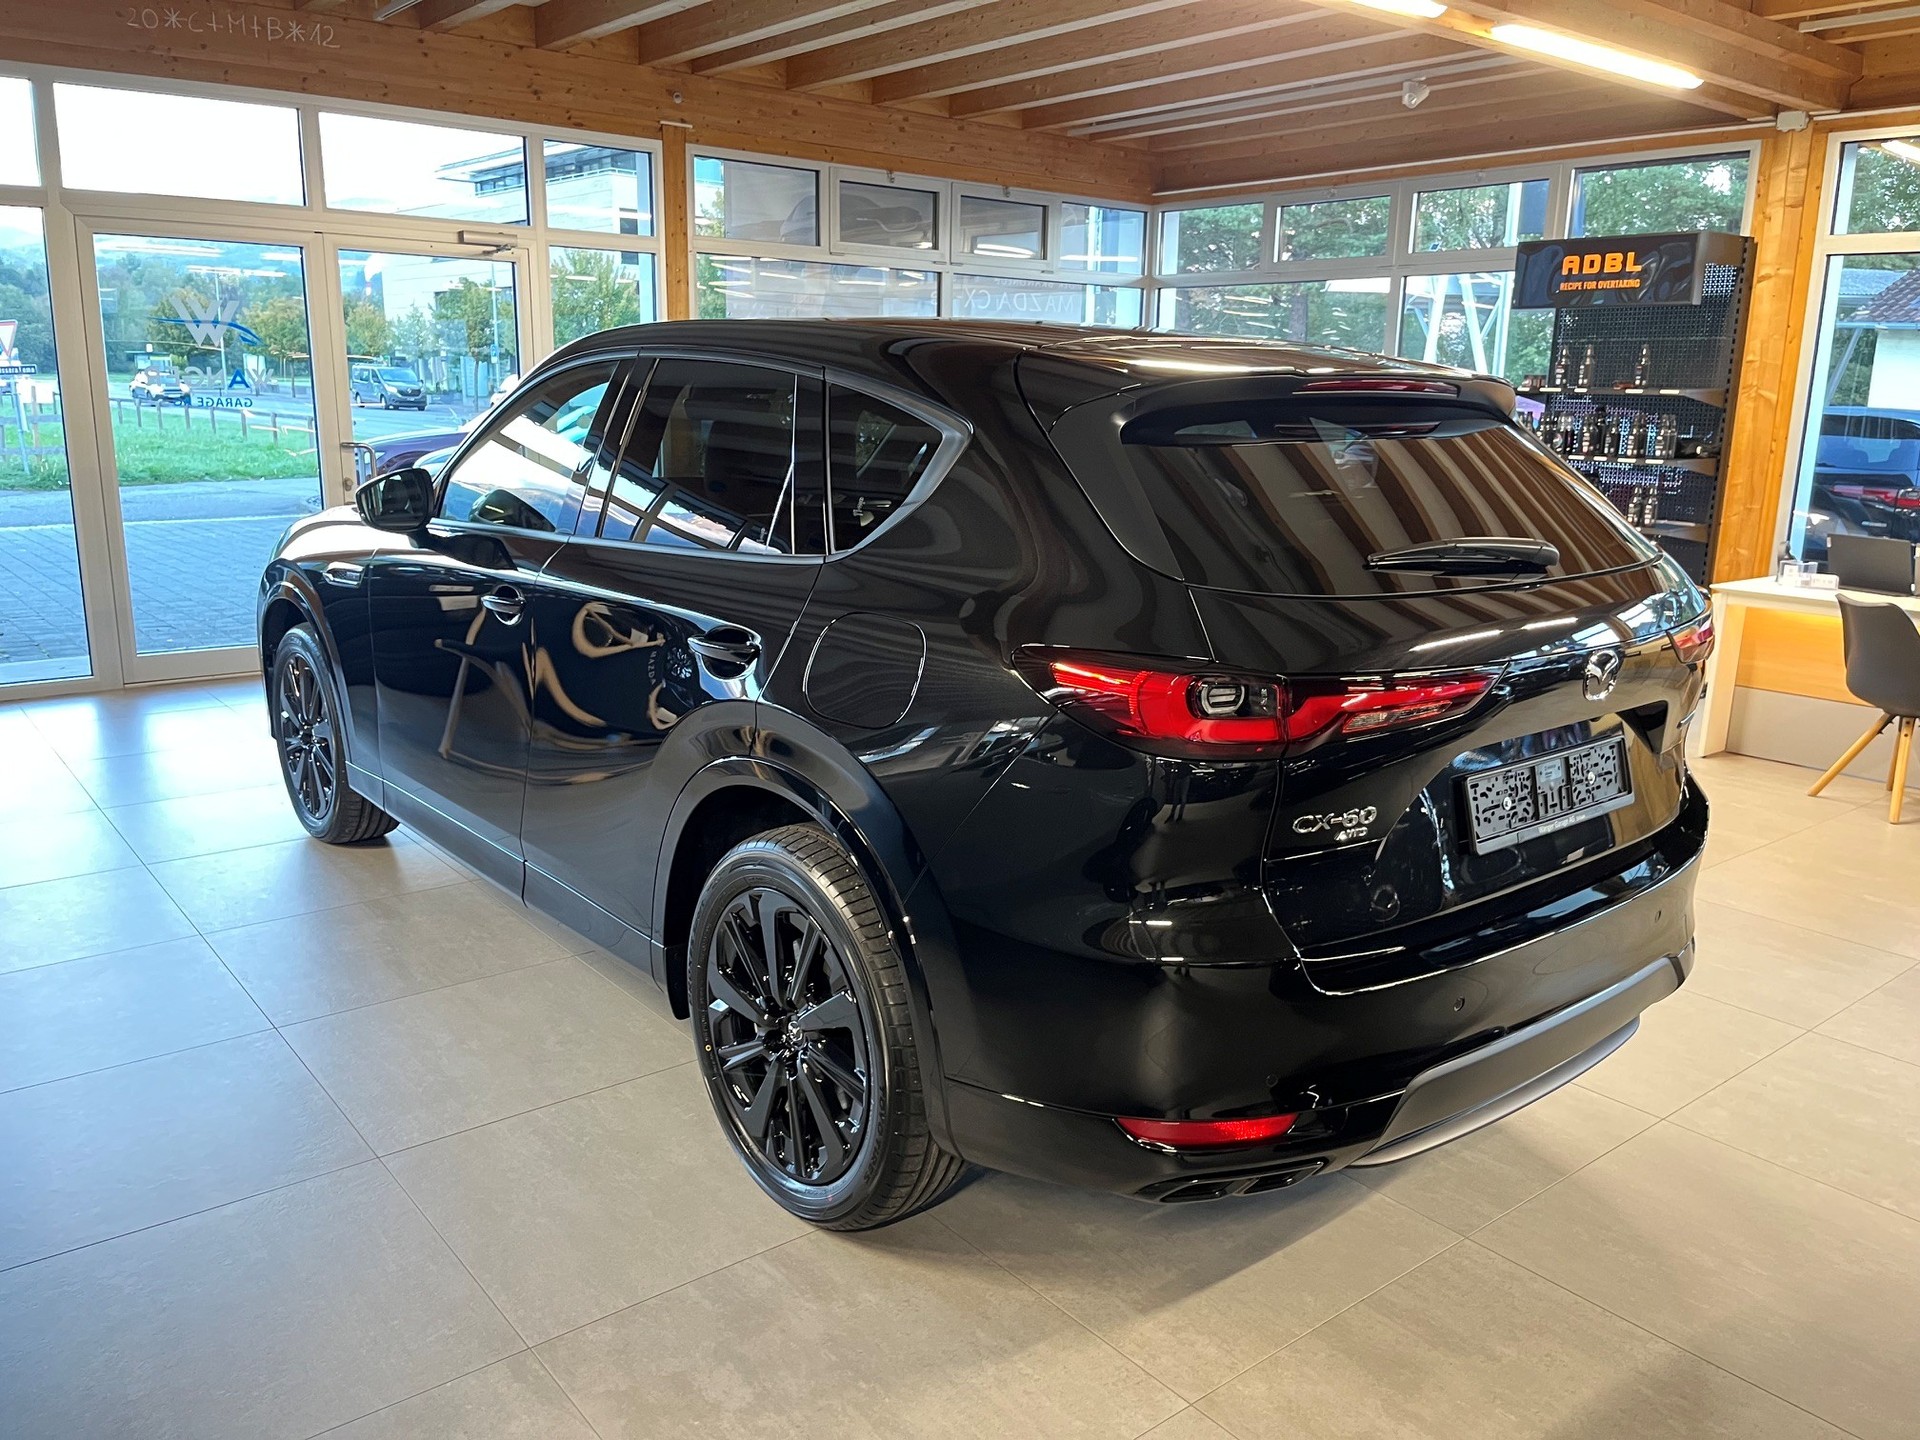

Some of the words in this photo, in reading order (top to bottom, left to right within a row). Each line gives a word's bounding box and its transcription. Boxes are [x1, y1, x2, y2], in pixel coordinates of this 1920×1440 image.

[1561, 251, 1642, 275] ADBL
[1560, 282, 1582, 290] RECIPE
[1584, 281, 1597, 289] FOR
[1598, 279, 1640, 288] OVERTAKING
[1292, 806, 1377, 833] CX-60
[1334, 827, 1368, 841] AWD
